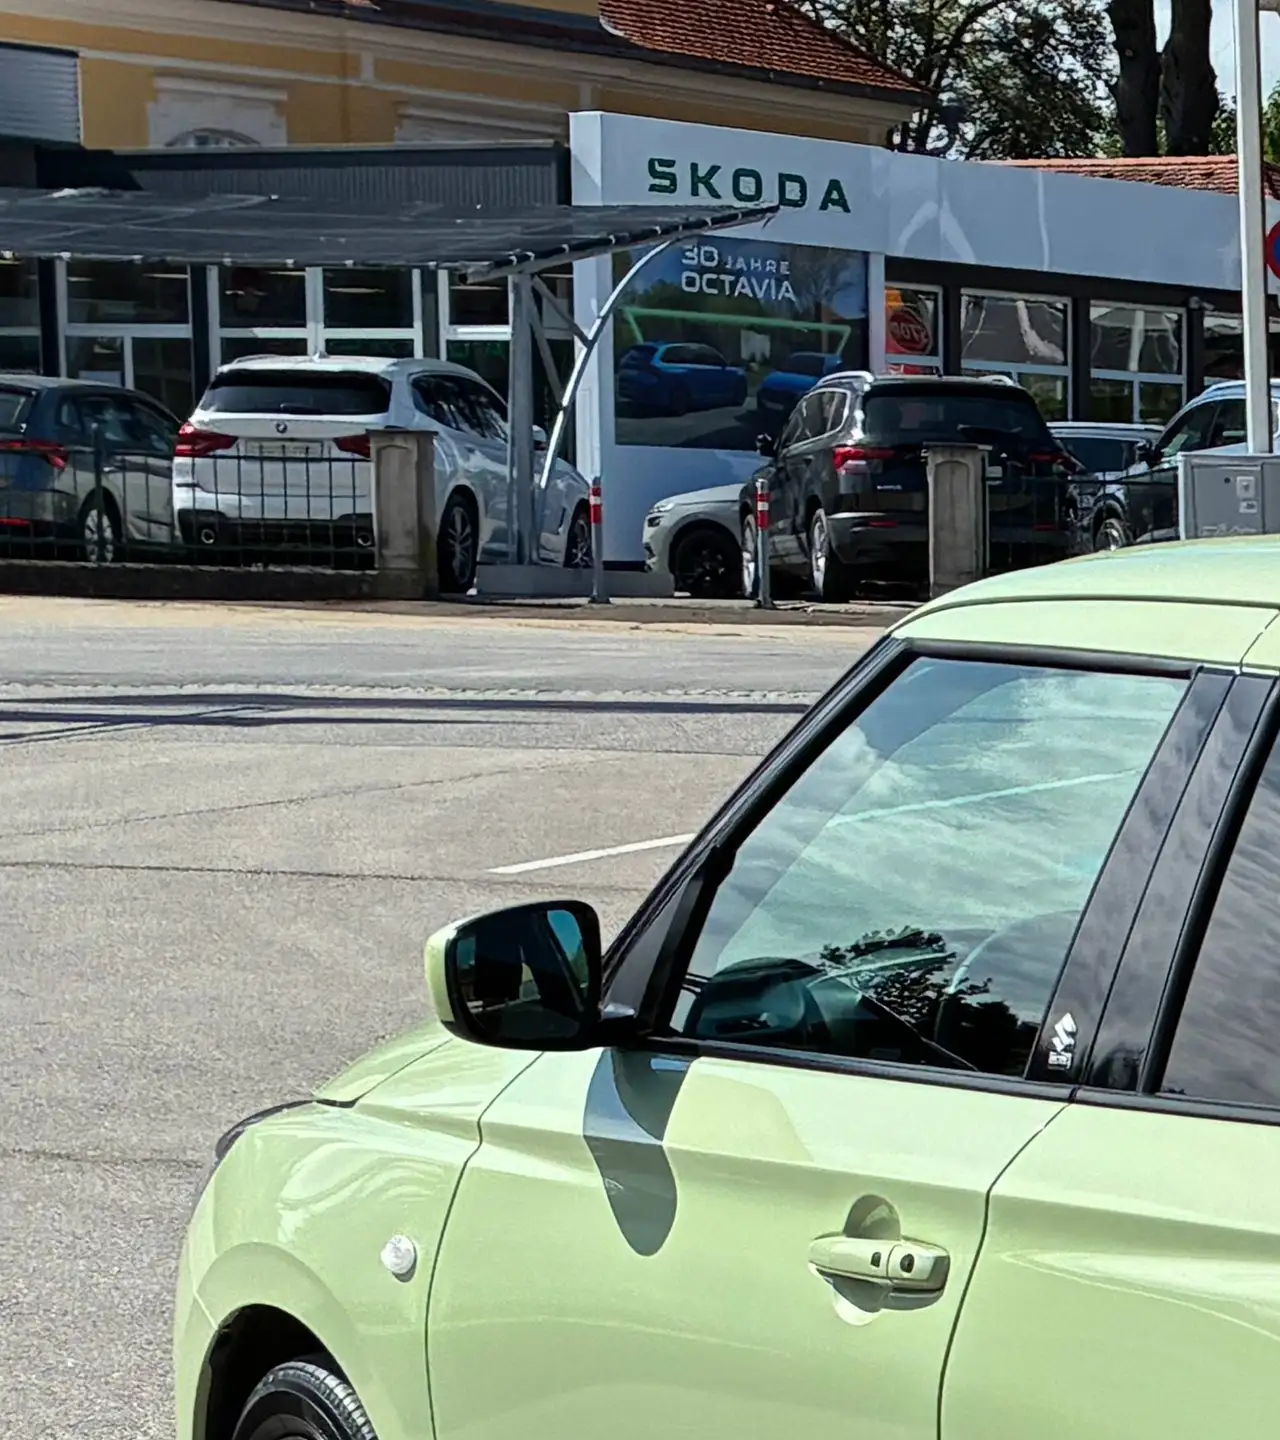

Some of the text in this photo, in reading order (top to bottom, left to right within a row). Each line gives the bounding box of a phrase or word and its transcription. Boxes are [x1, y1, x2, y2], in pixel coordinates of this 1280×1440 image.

[647, 157, 852, 213] SKODA
[681, 245, 790, 275] 30 JAHRE
[681, 270, 797, 303] OCTAVIA
